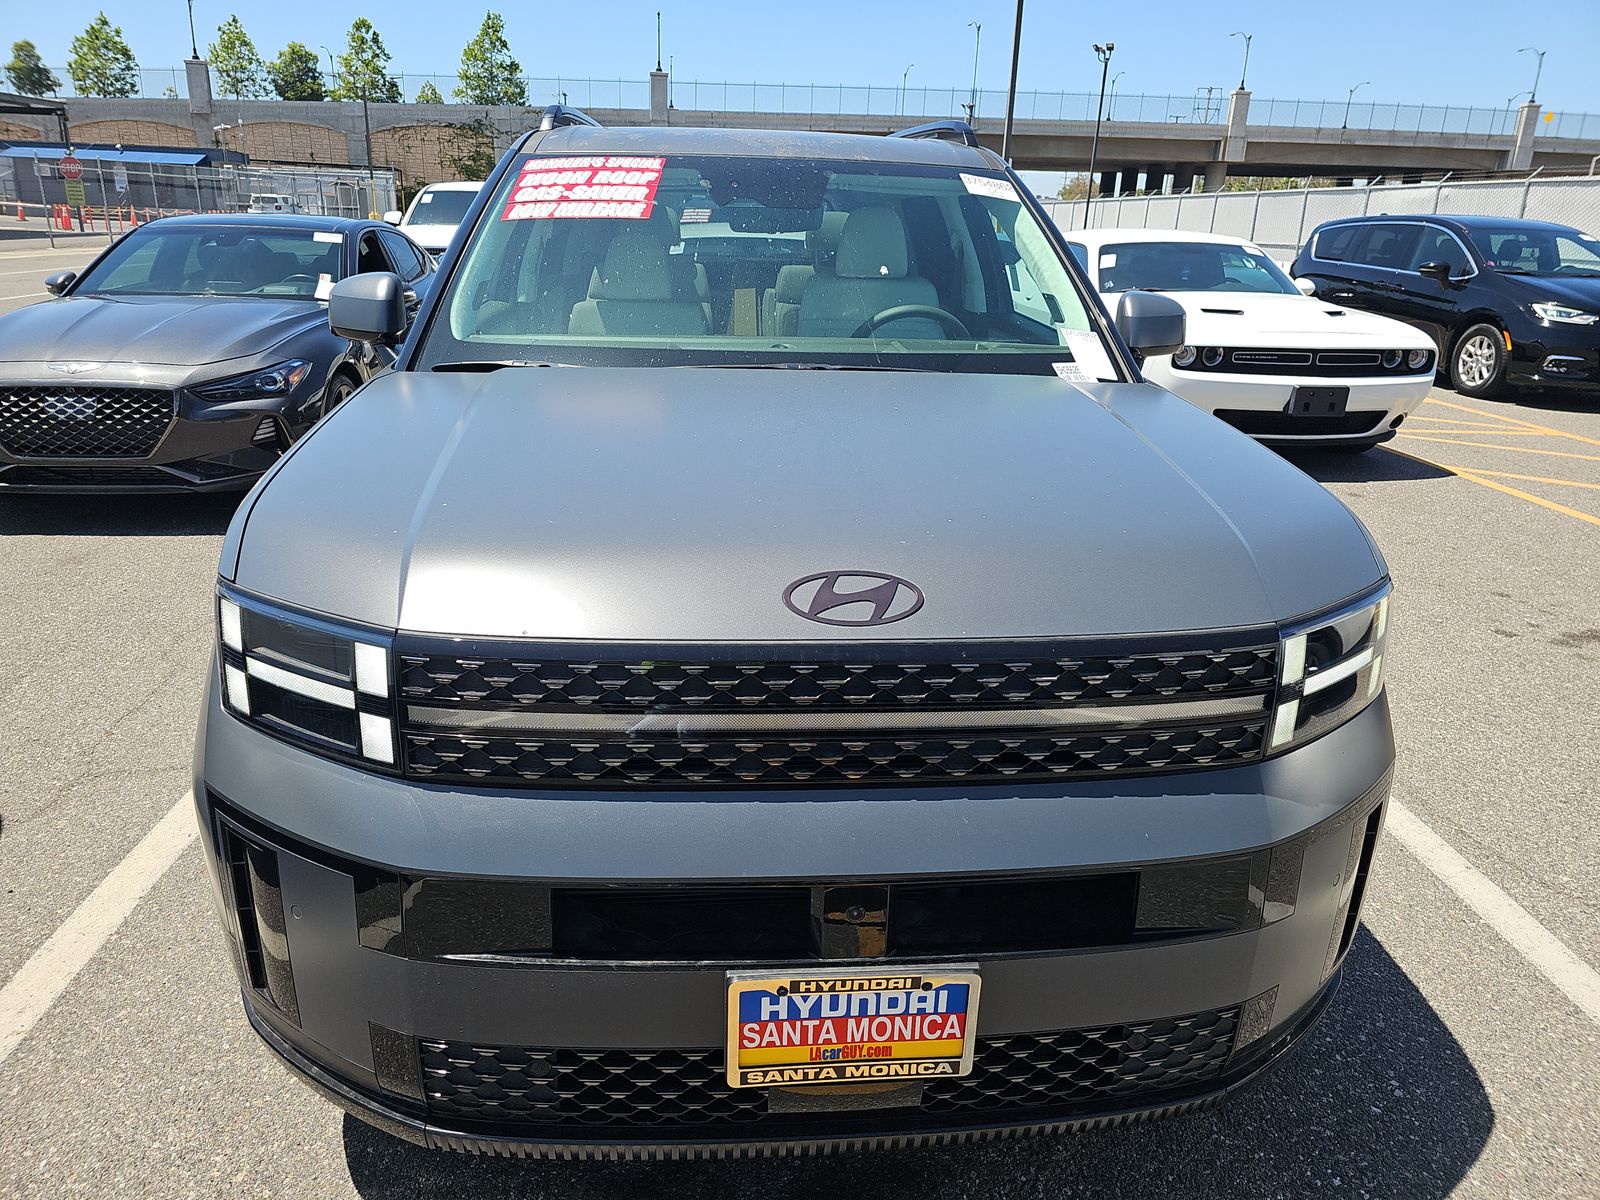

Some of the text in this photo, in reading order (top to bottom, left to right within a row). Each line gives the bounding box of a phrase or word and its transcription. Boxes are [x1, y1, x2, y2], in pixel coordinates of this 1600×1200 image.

[61, 163, 81, 173] STOP
[524, 156, 663, 171] MANAGER'S SPECIAL
[518, 170, 659, 188] MOON ROOF
[513, 185, 650, 203] GAS-SAVER
[507, 202, 648, 219] LOW MILEAGE
[799, 978, 913, 992] HYUNDAI
[760, 989, 949, 1021] HYUNDAI
[742, 1014, 962, 1048] SANTA MONICA
[809, 1044, 893, 1062] LAcarGUY.com
[746, 1062, 954, 1084] SANTA MONICA
